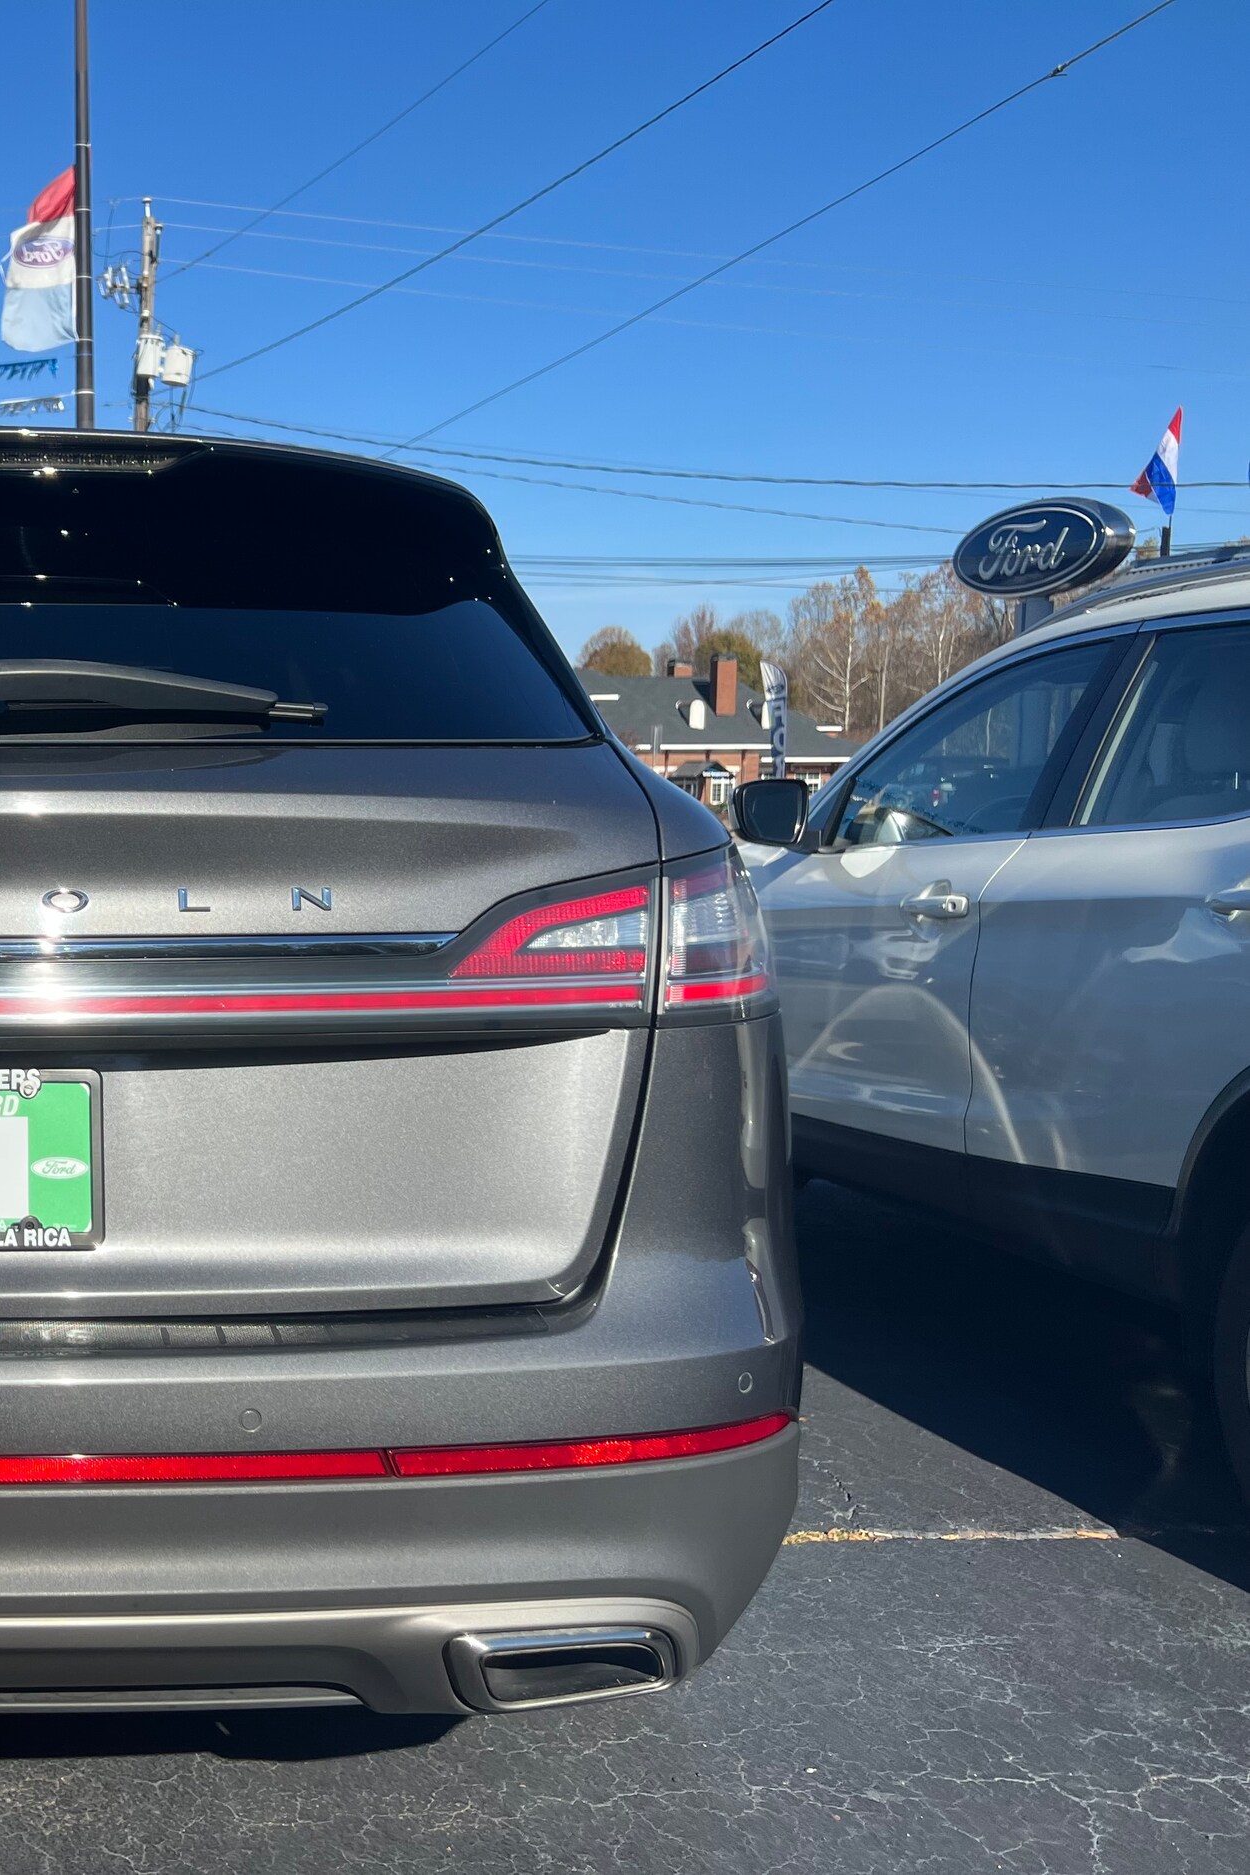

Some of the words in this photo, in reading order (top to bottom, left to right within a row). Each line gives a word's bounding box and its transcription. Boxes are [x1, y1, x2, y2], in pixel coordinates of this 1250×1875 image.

[978, 518, 1071, 581] Ford
[41, 1159, 77, 1175] Ford
[23, 1227, 72, 1247] RICA
